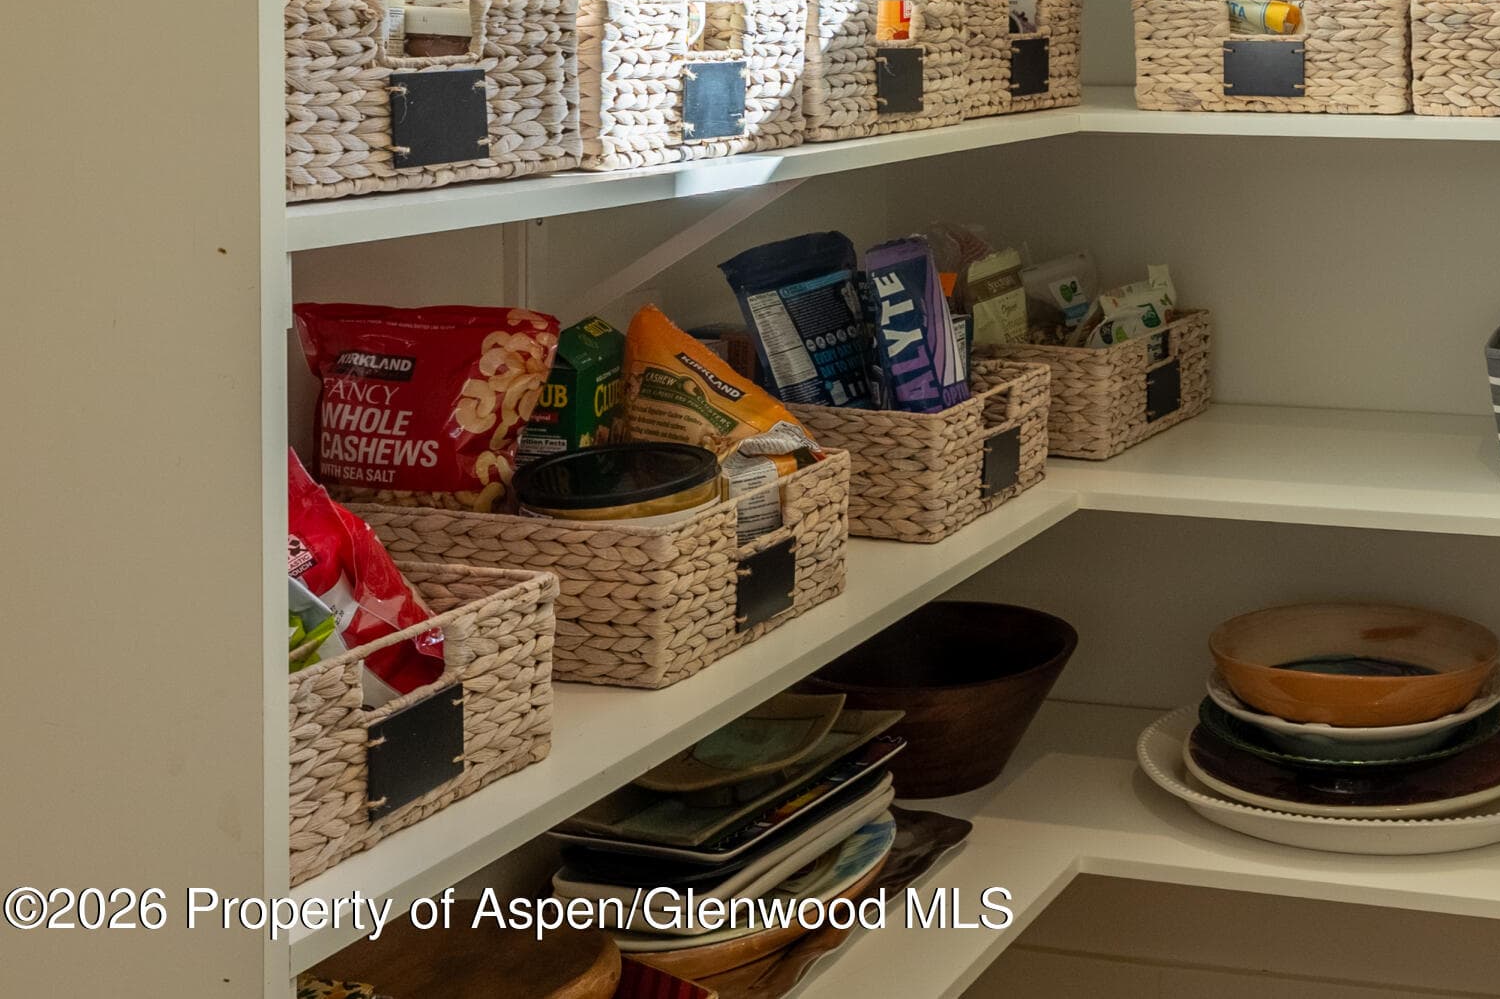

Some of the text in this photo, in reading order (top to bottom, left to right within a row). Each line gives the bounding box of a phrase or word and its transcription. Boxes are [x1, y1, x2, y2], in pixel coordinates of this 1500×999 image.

[337, 352, 413, 372] KIRKLAND
[645, 371, 677, 386] CASHEW
[681, 354, 742, 399] KIRKLAND
[323, 377, 400, 406] FANCY
[539, 383, 569, 408] UB
[321, 402, 414, 436] WHOLE
[320, 431, 439, 468] CASHEWS
[321, 462, 396, 483] WITH SEA SALT
